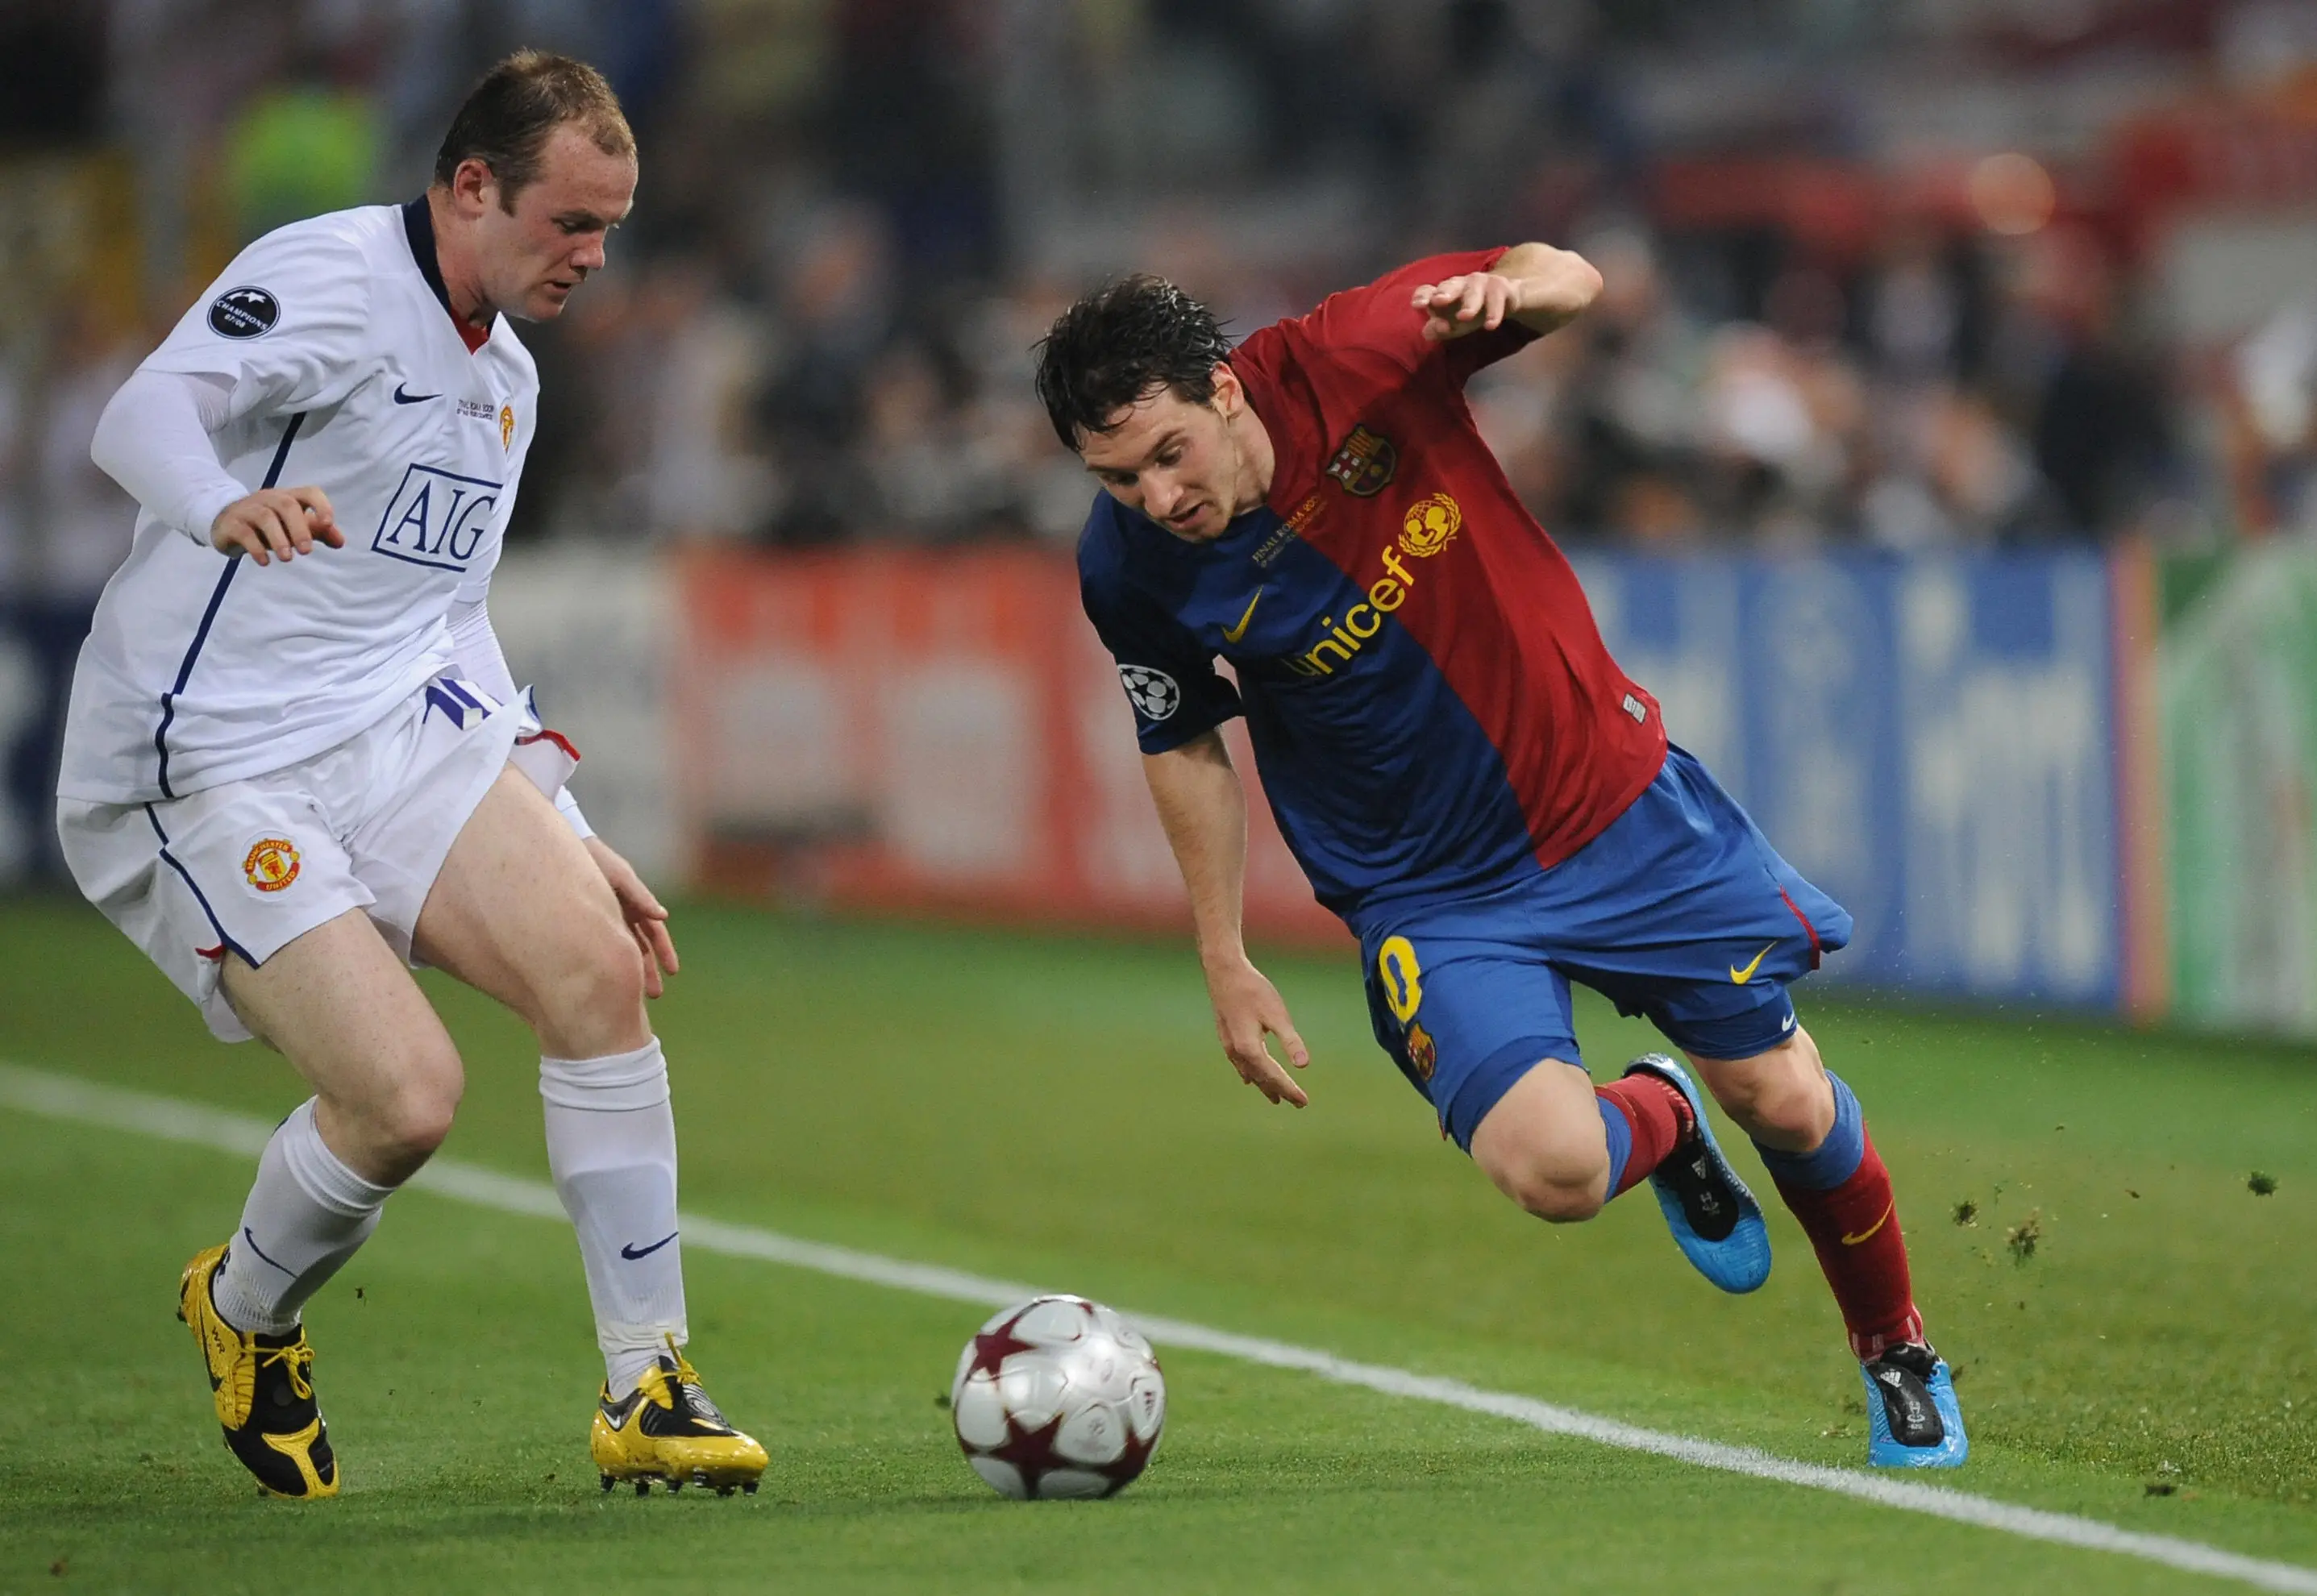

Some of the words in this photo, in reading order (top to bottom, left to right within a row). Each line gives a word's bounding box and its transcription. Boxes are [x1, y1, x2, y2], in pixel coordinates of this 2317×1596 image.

[216, 300, 268, 330] CHAMPIONS
[385, 480, 497, 560] AIG
[1252, 537, 1279, 562] FINAL
[1277, 511, 1305, 538] ROMA
[1279, 545, 1414, 676] unicef
